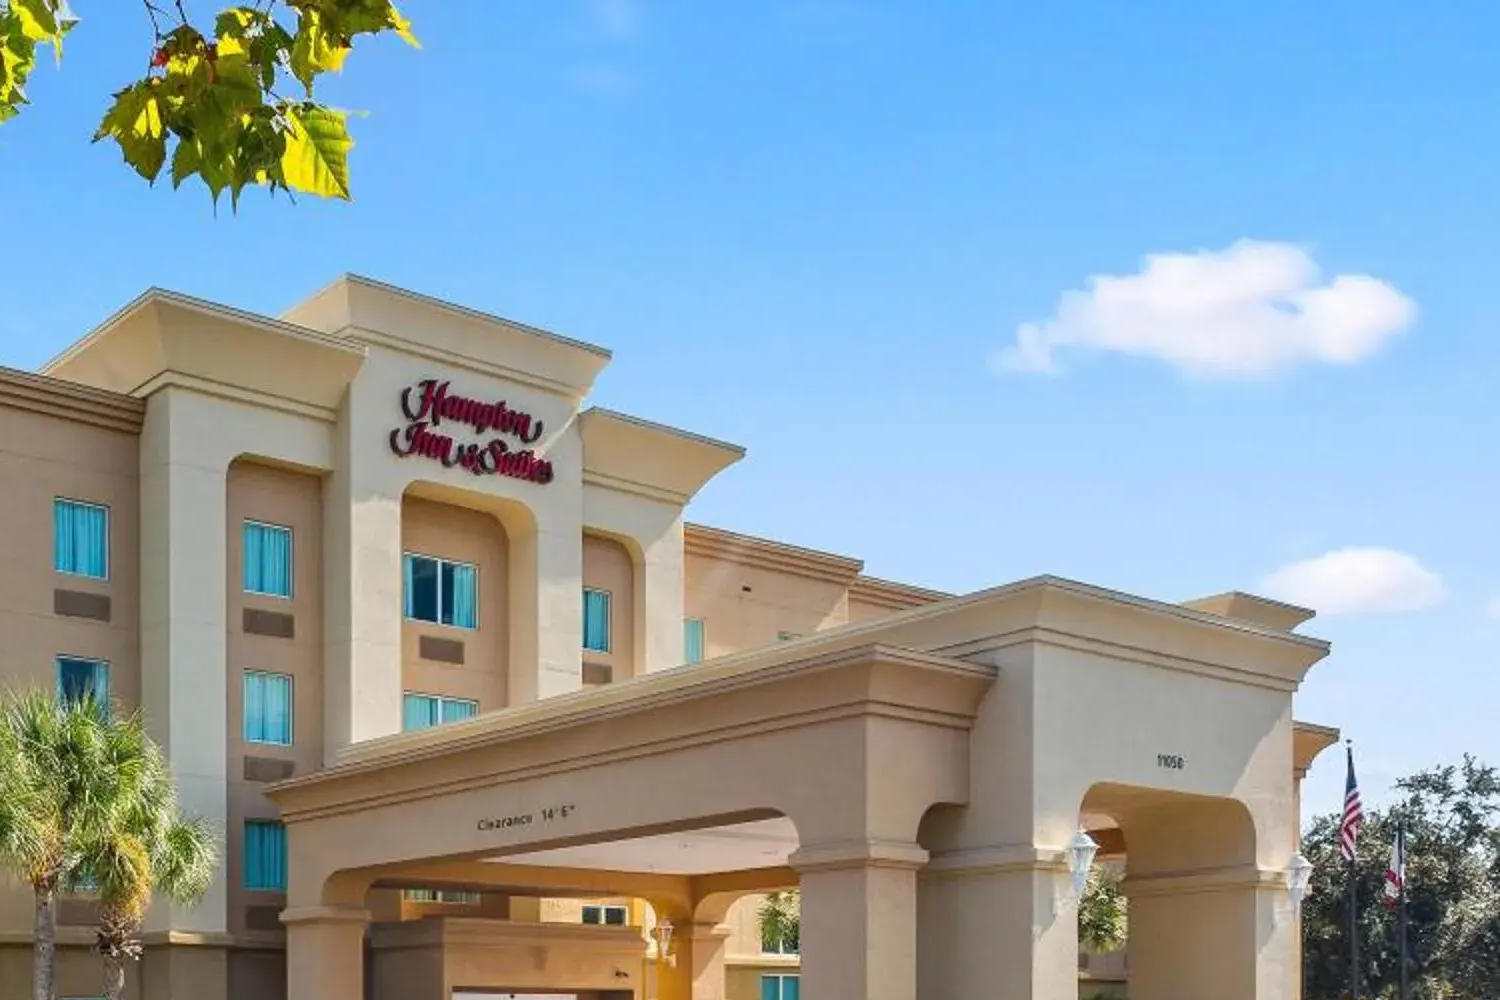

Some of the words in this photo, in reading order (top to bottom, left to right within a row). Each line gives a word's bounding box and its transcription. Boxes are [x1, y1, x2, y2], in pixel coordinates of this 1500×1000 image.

[401, 379, 543, 443] Hampton
[390, 422, 464, 468] Inn
[460, 443, 483, 475] &
[479, 439, 553, 484] Suites
[477, 815, 533, 831] Clearance
